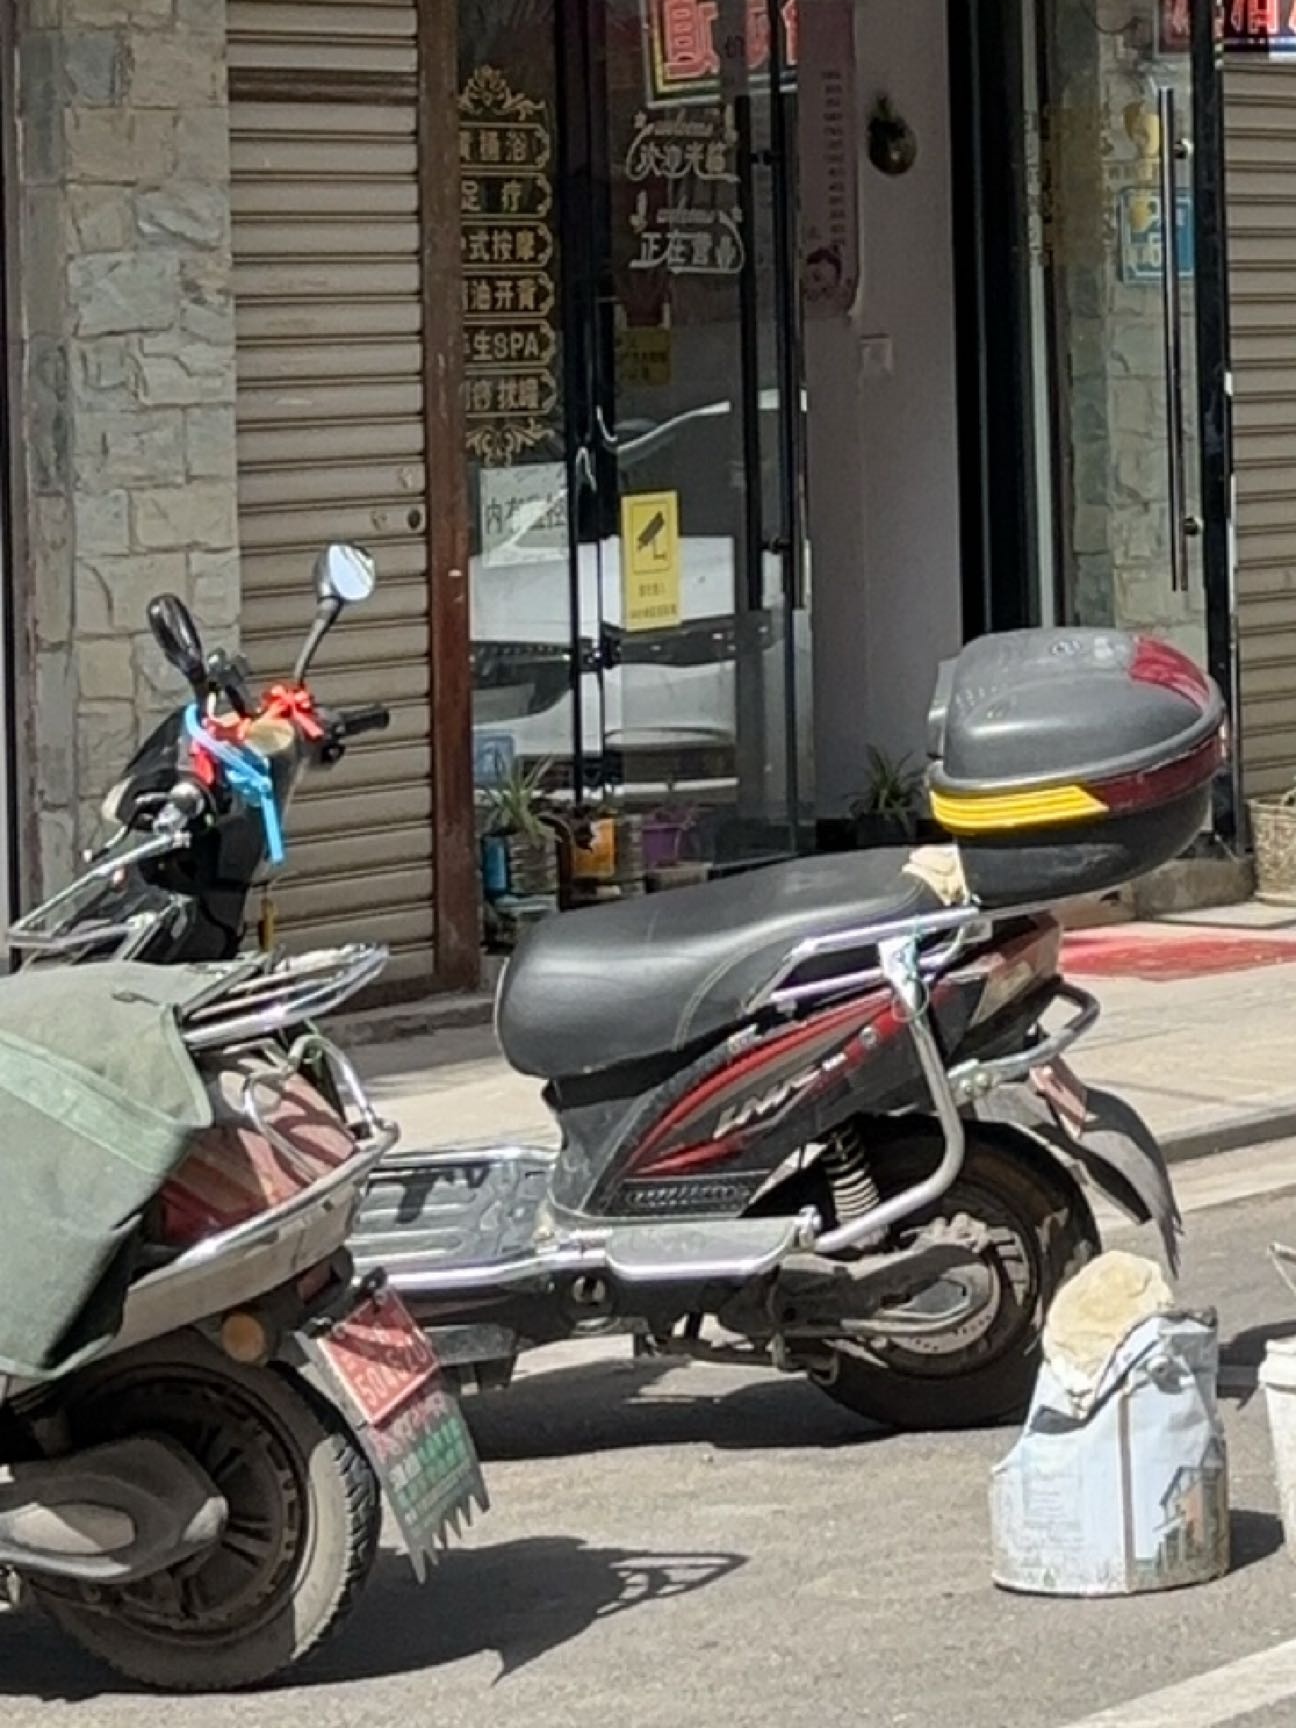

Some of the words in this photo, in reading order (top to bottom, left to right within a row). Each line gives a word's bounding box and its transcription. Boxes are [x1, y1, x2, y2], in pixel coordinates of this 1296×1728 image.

[460, 229, 537, 261] 式按摩
[463, 279, 537, 311] 油开背
